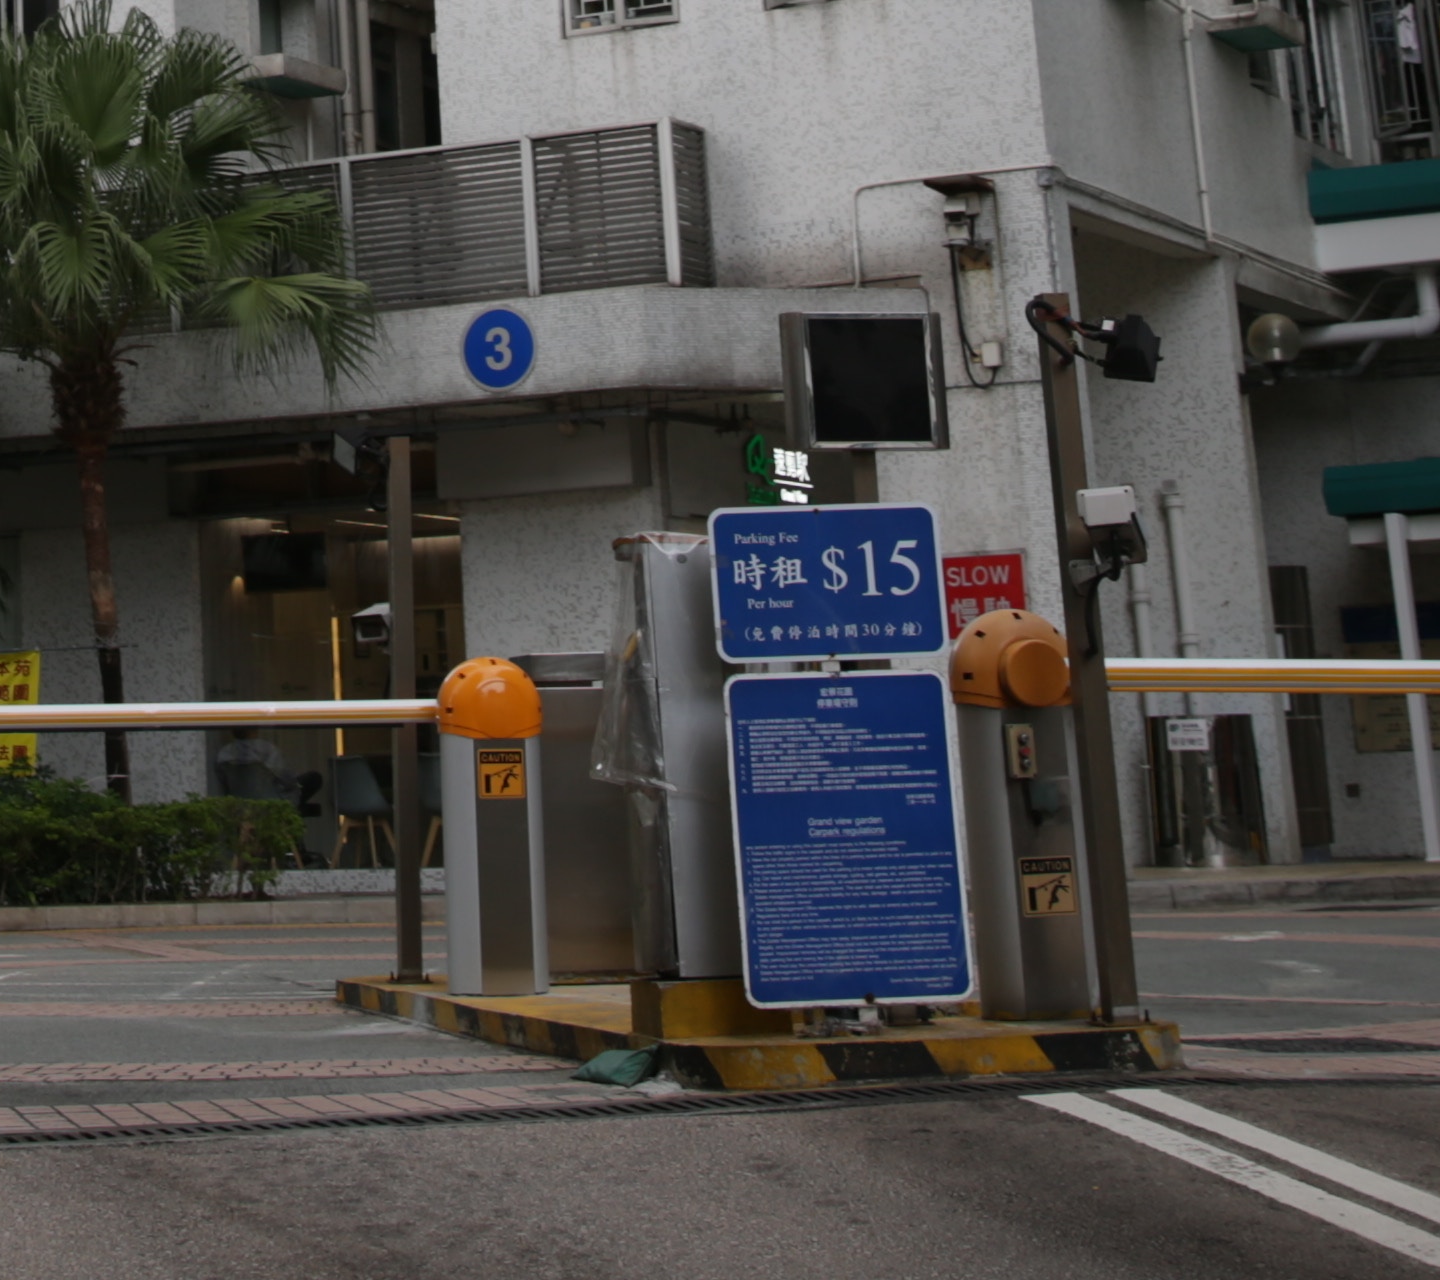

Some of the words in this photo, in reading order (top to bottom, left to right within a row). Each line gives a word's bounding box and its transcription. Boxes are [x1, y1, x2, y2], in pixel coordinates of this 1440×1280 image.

[485, 327, 513, 371] 3
[733, 532, 776, 546] Parking
[778, 531, 799, 544] Fee
[732, 552, 809, 592] 時租
[820, 538, 922, 595] $15
[945, 564, 1010, 588] SLOW
[747, 597, 765, 610] Per
[769, 596, 795, 609] hour
[481, 752, 521, 762] CAUTION
[806, 816, 833, 827] Grand
[835, 817, 853, 827] view
[855, 816, 884, 828] garden
[807, 826, 841, 838] Carpark
[842, 825, 887, 837] regulations
[1022, 859, 1070, 873] CAUTION
